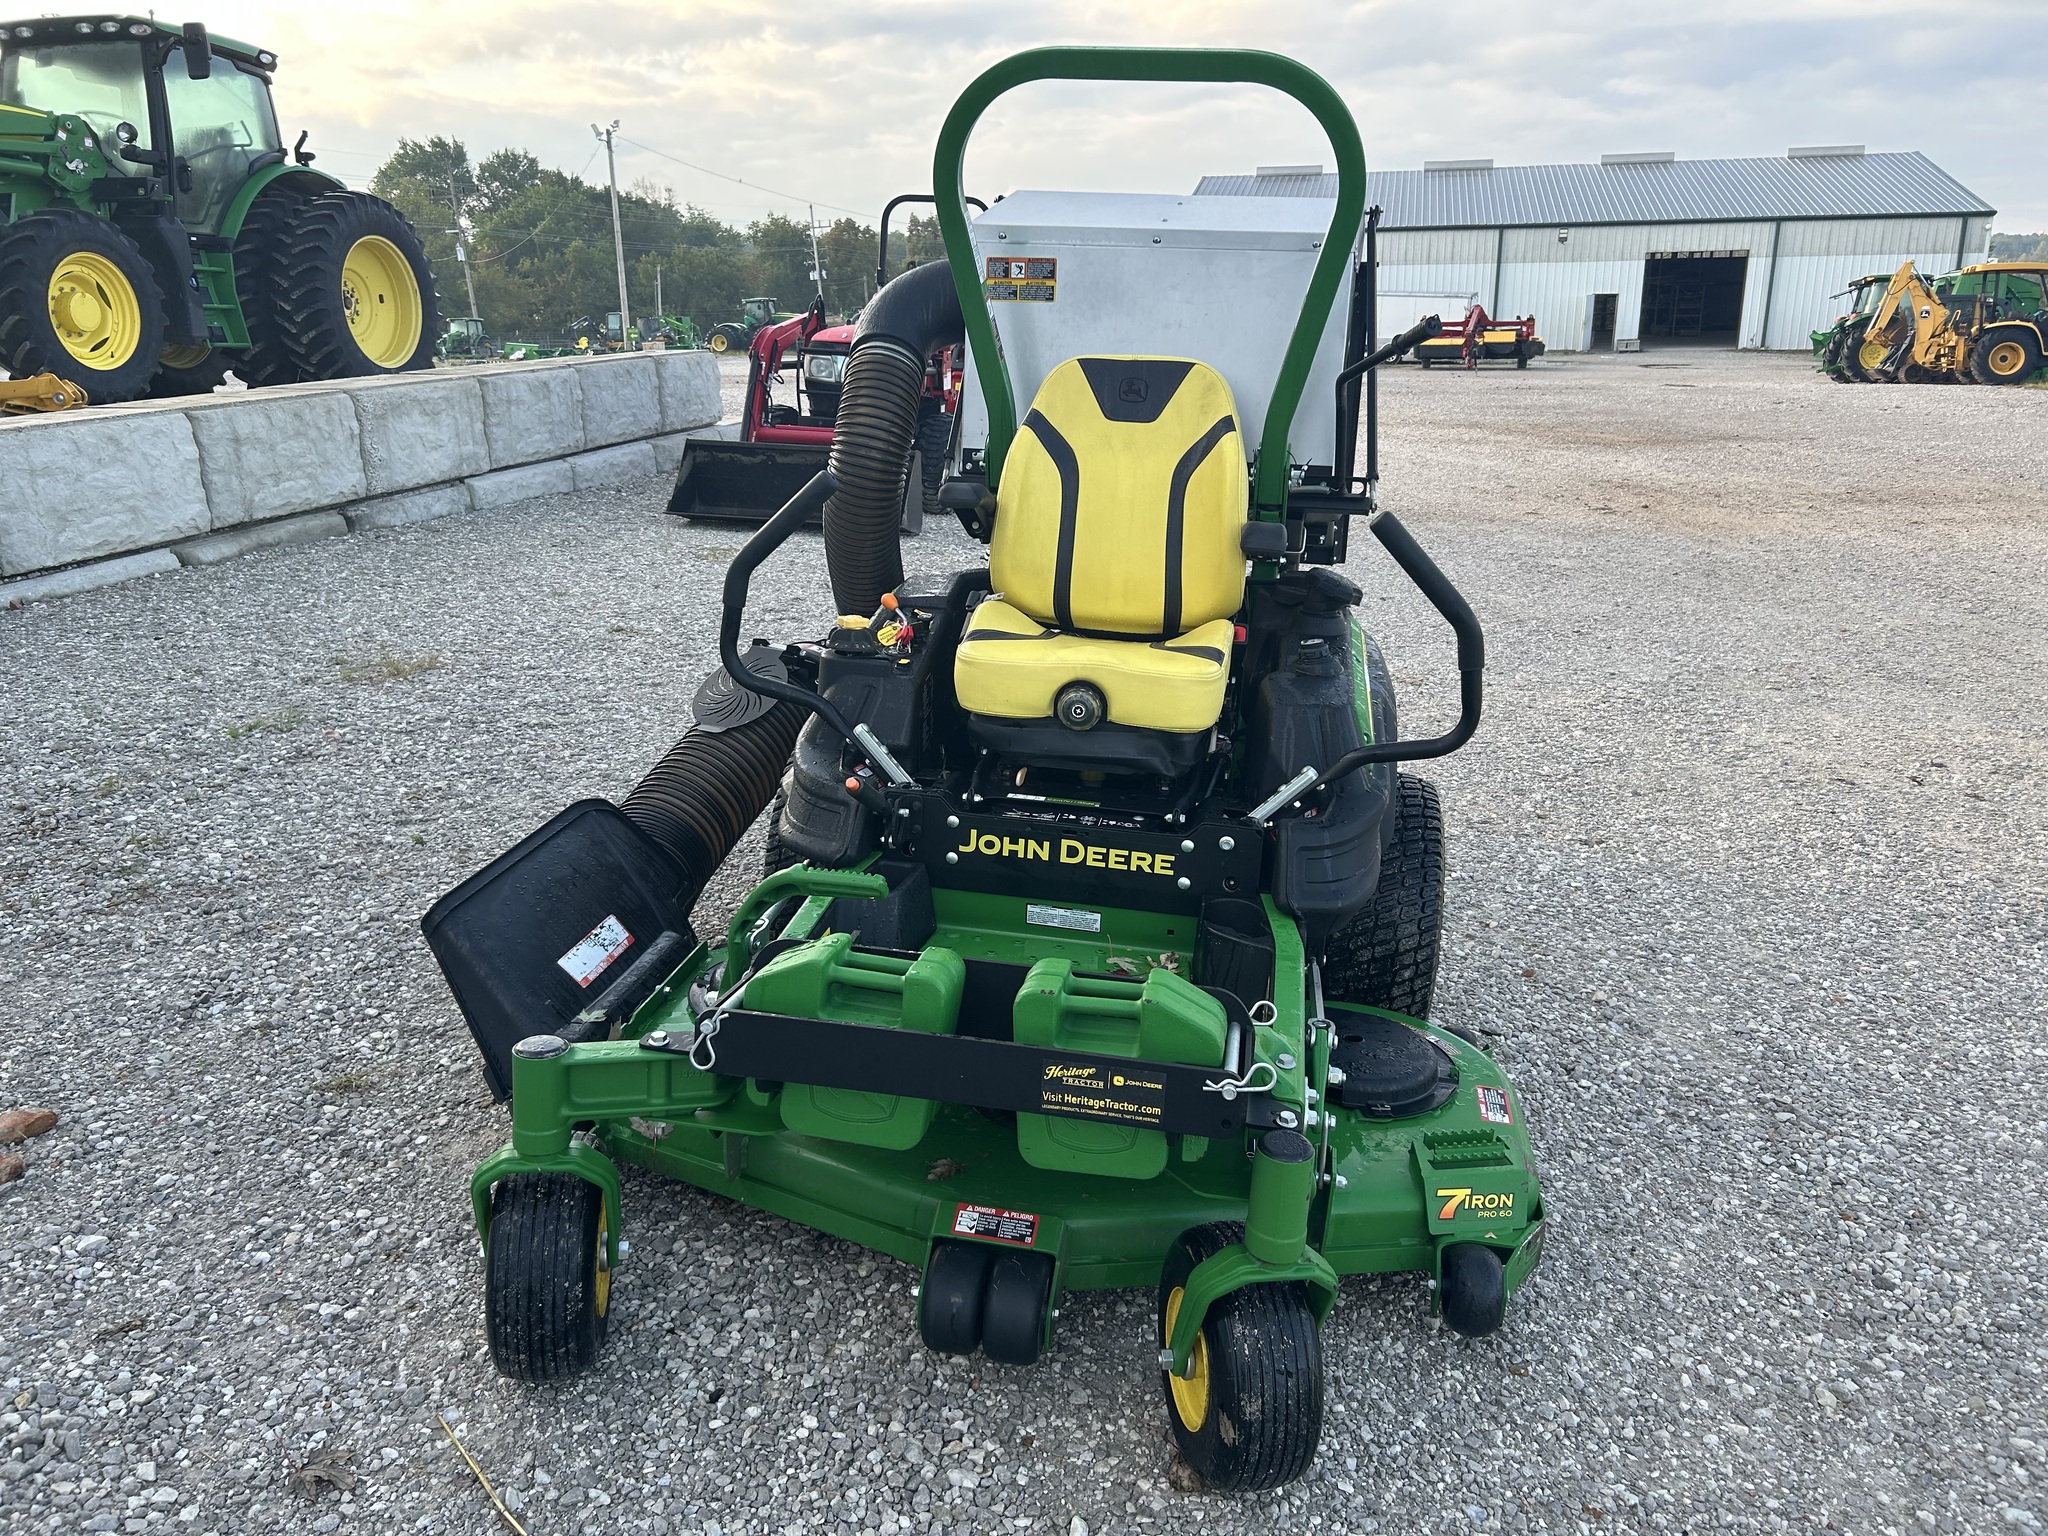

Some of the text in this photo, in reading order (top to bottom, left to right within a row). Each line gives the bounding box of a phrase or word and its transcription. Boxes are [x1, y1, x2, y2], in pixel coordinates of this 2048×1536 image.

[958, 829, 1175, 876] JOHN DEERE
[1044, 1064, 1096, 1080] Heritage
[1062, 1078, 1104, 1088] TRACTOR
[1142, 1081, 1162, 1089] DEERE
[1042, 1091, 1161, 1115] Visit HeritageTractor.com
[974, 1206, 996, 1214] DANGER
[1010, 1212, 1034, 1220] PELIGRO
